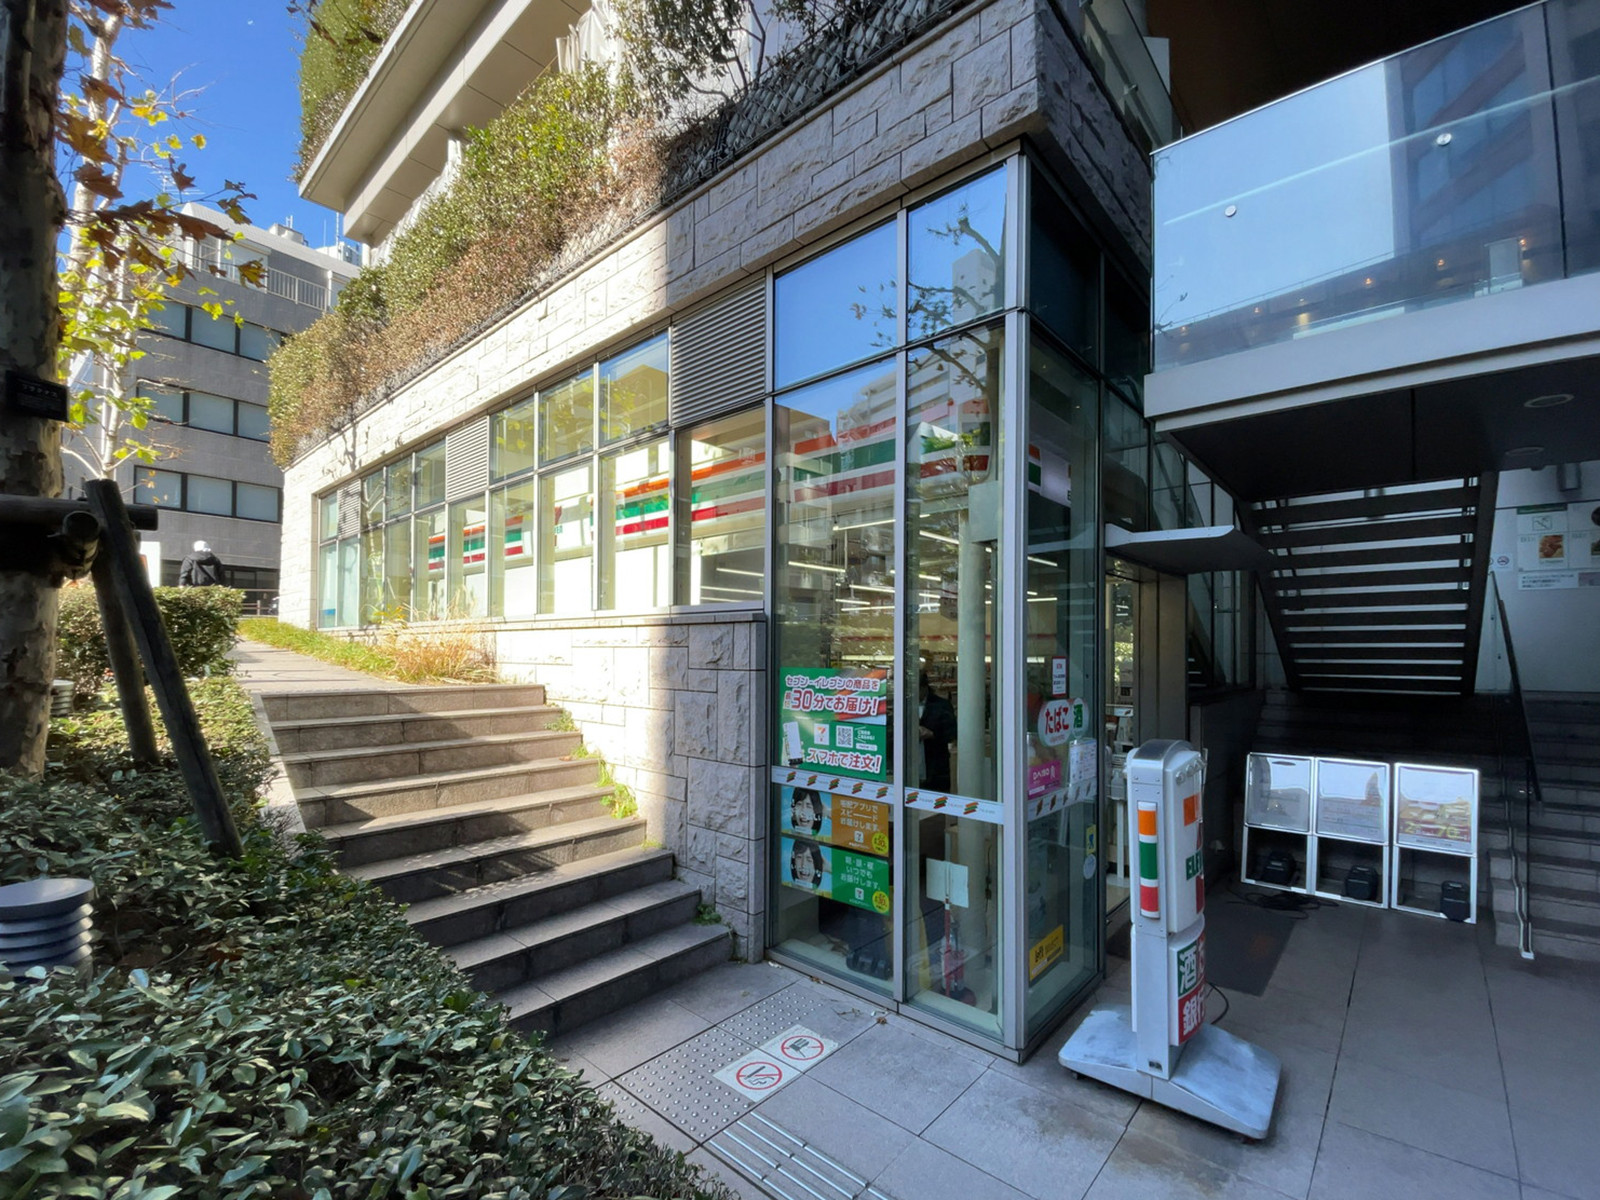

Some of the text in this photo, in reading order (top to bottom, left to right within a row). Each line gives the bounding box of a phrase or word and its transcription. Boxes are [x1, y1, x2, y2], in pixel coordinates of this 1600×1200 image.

[1045, 705, 1070, 735] たばこ
[1073, 703, 1083, 728] 酒
[807, 747, 882, 774] スマホで注文!
[1179, 944, 1198, 993] 酒
